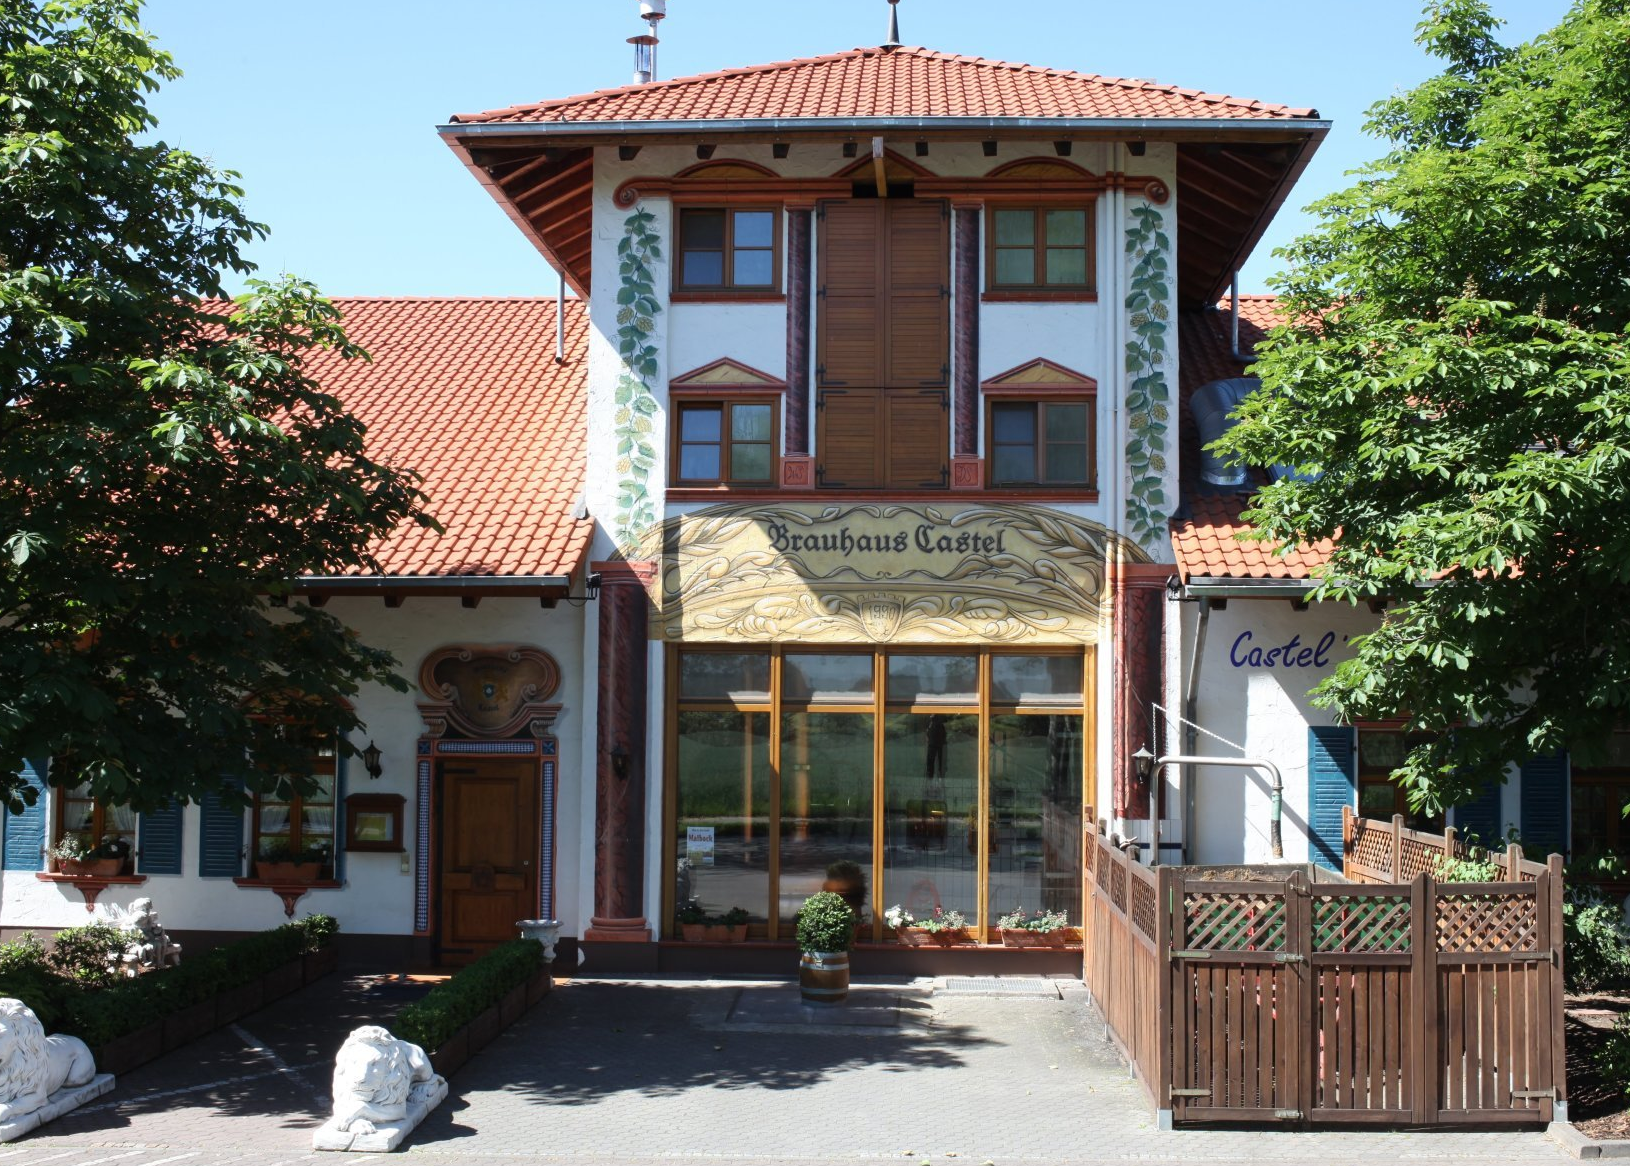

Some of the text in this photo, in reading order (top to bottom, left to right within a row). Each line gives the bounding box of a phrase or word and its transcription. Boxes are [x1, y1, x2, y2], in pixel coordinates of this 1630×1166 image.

[768, 523, 1006, 557] Brauhaus Castel
[868, 604, 896, 621] 1990
